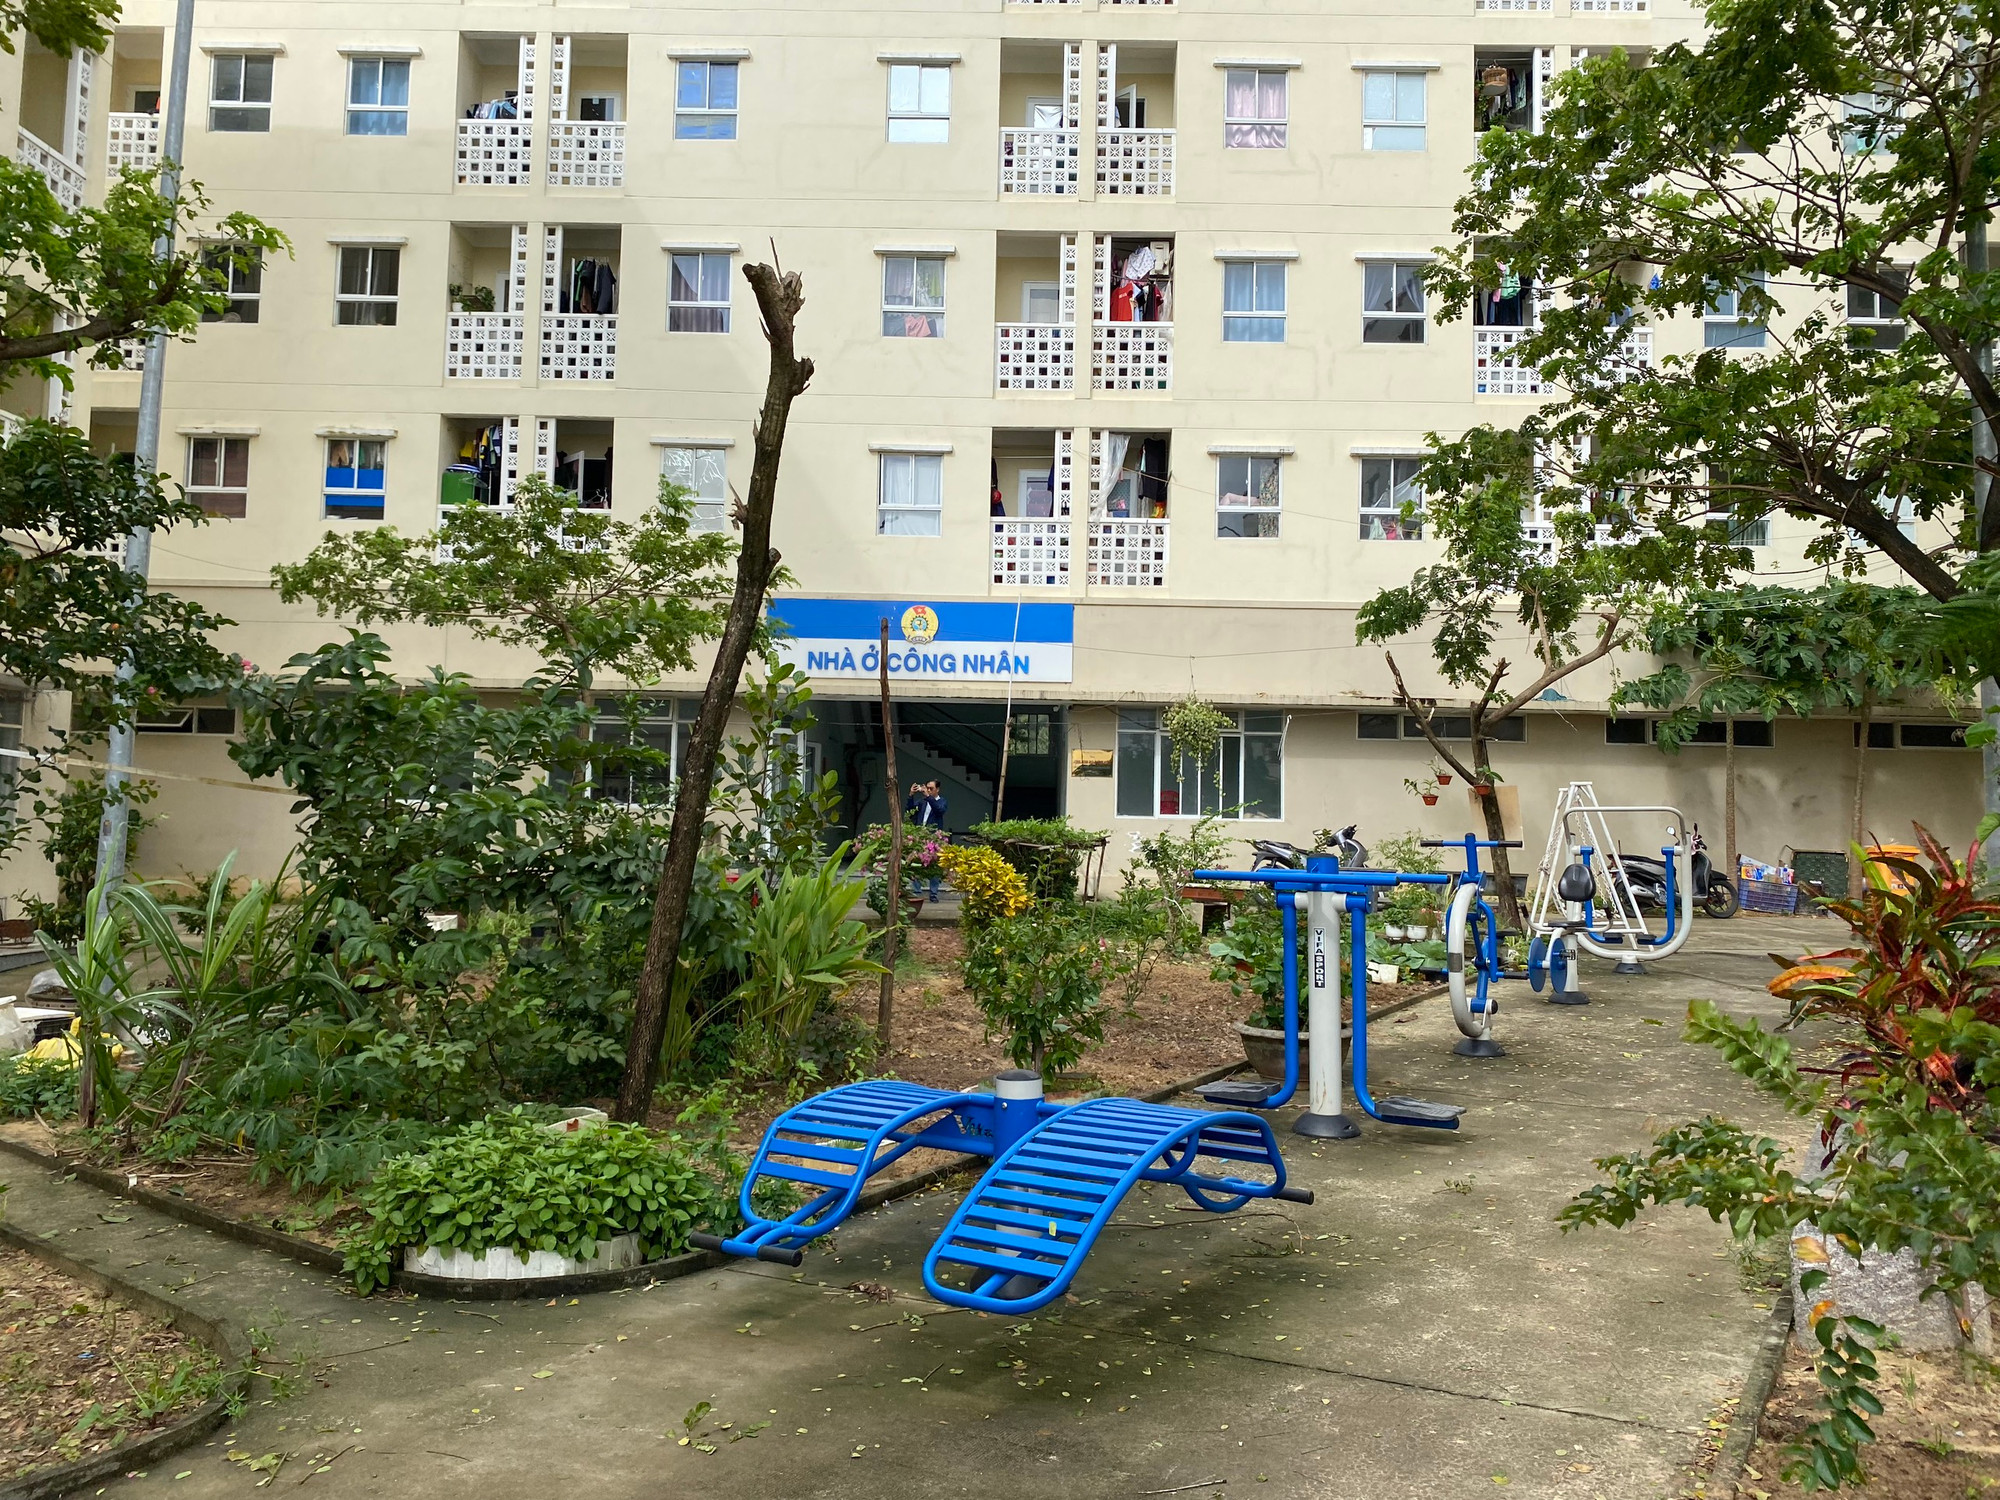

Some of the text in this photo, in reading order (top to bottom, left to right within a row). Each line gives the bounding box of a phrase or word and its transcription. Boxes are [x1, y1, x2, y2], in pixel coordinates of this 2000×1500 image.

[807, 644, 1029, 674] NHÀ Ở CÔNG NHÂN
